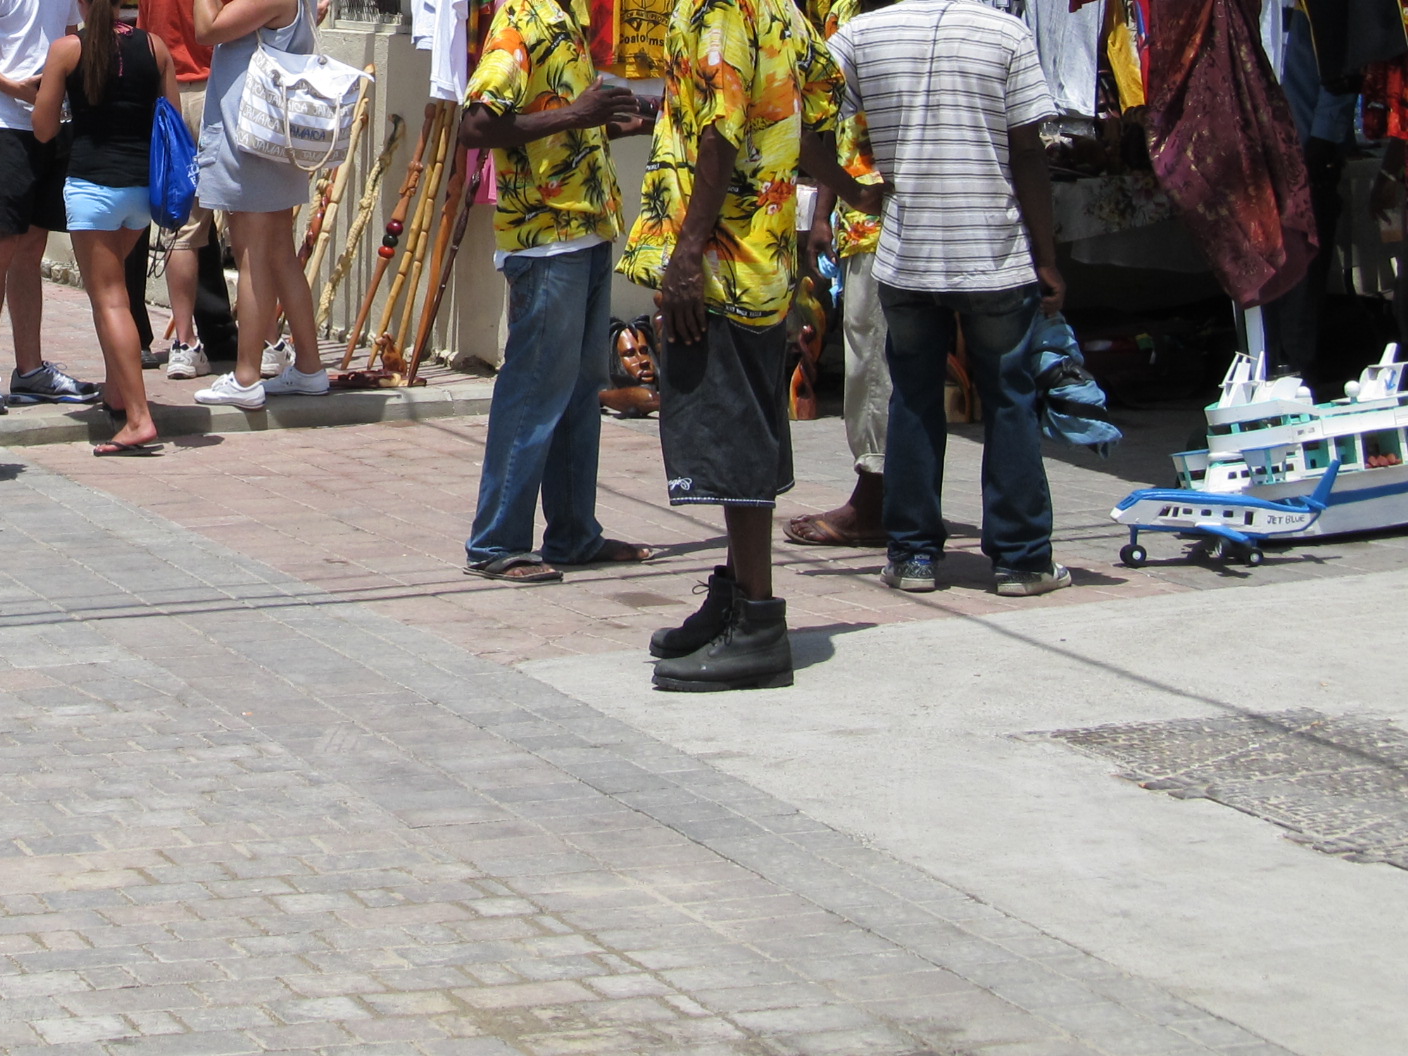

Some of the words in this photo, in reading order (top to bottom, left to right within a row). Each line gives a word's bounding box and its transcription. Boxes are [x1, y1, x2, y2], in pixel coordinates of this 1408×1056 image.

[266, 90, 309, 113] JAMICA
[242, 104, 280, 131] JAMAICA
[1267, 515, 1283, 524] JET
[1285, 515, 1305, 524] BLUE
